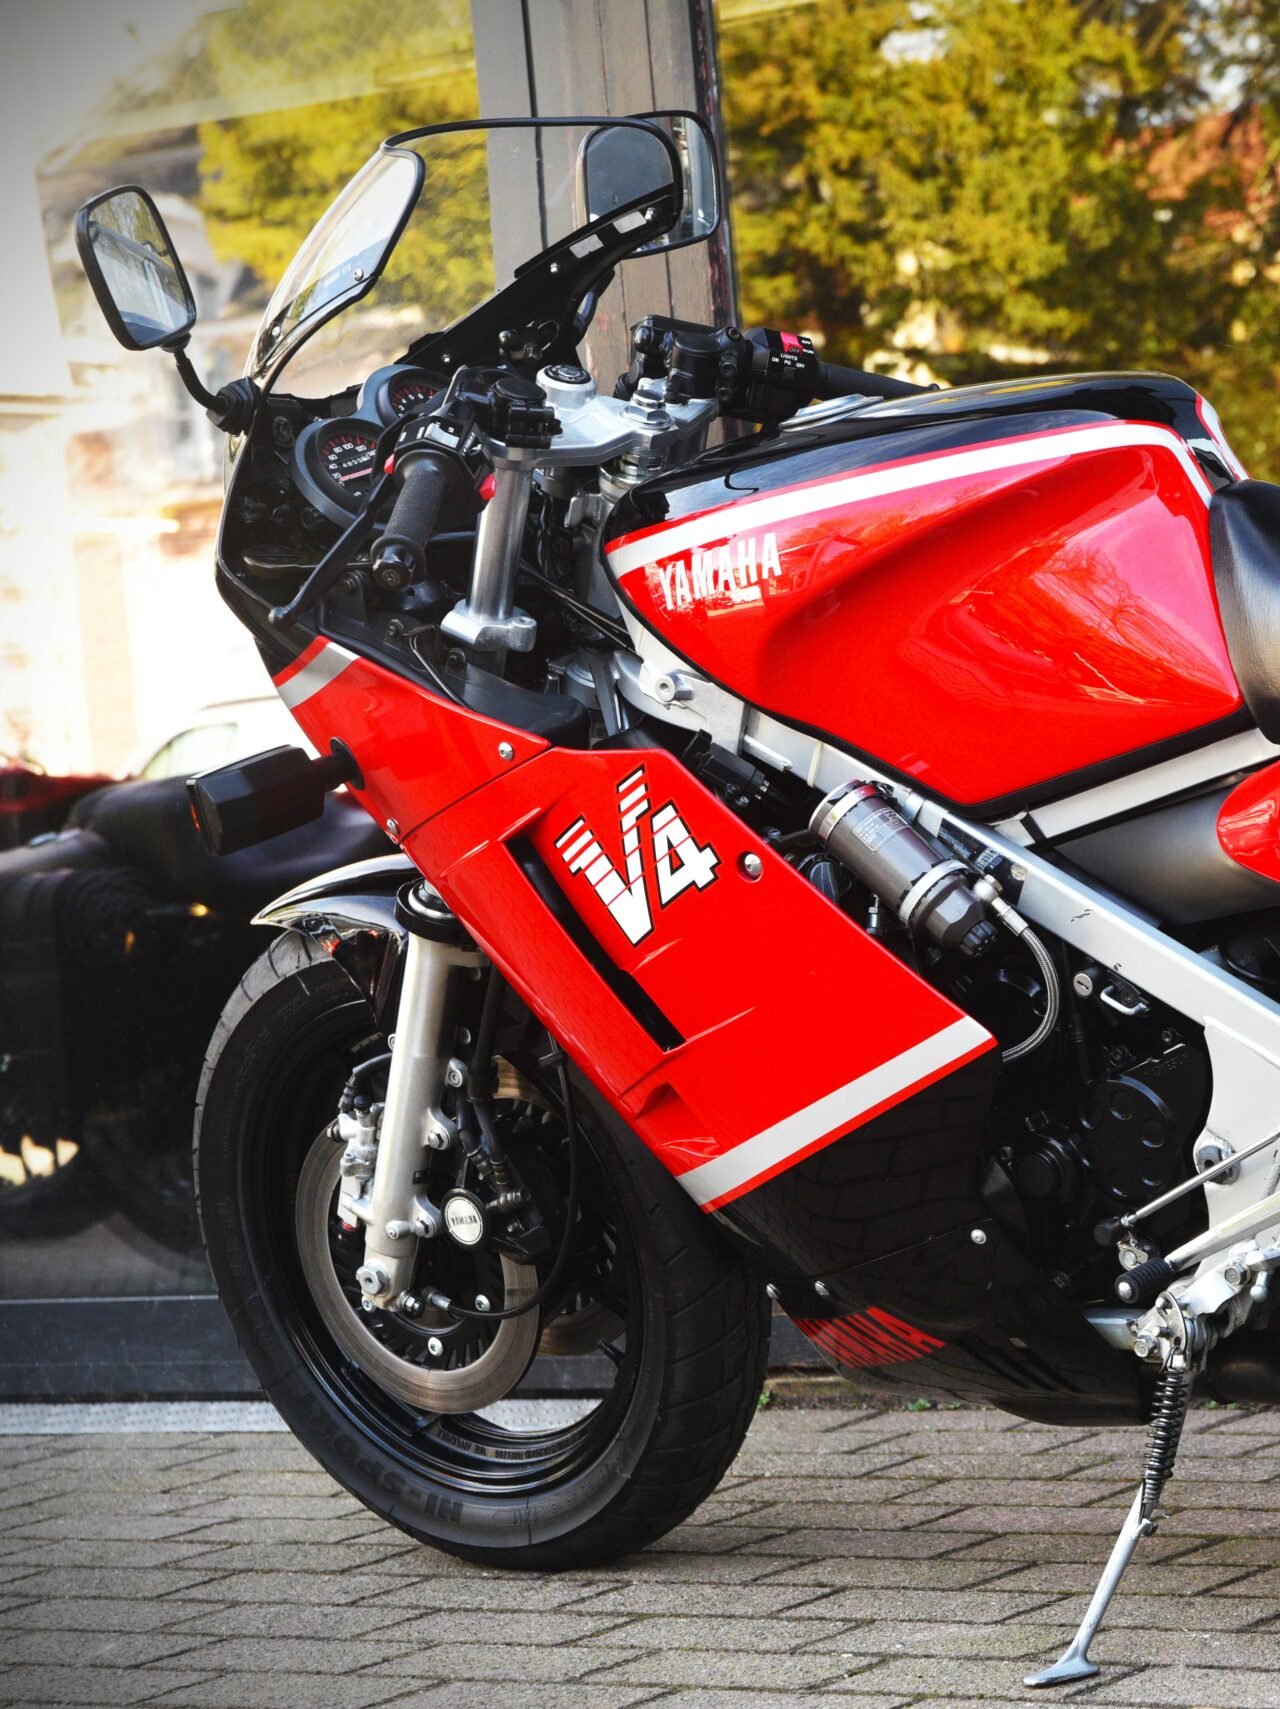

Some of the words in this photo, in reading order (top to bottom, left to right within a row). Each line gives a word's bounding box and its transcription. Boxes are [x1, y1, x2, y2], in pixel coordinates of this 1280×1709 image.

[780, 353, 798, 361] LIGHTS
[342, 442, 354, 450] 100
[658, 532, 782, 611] YAMAHA
[554, 763, 722, 948] V4
[450, 1214, 479, 1227] YAMAHA
